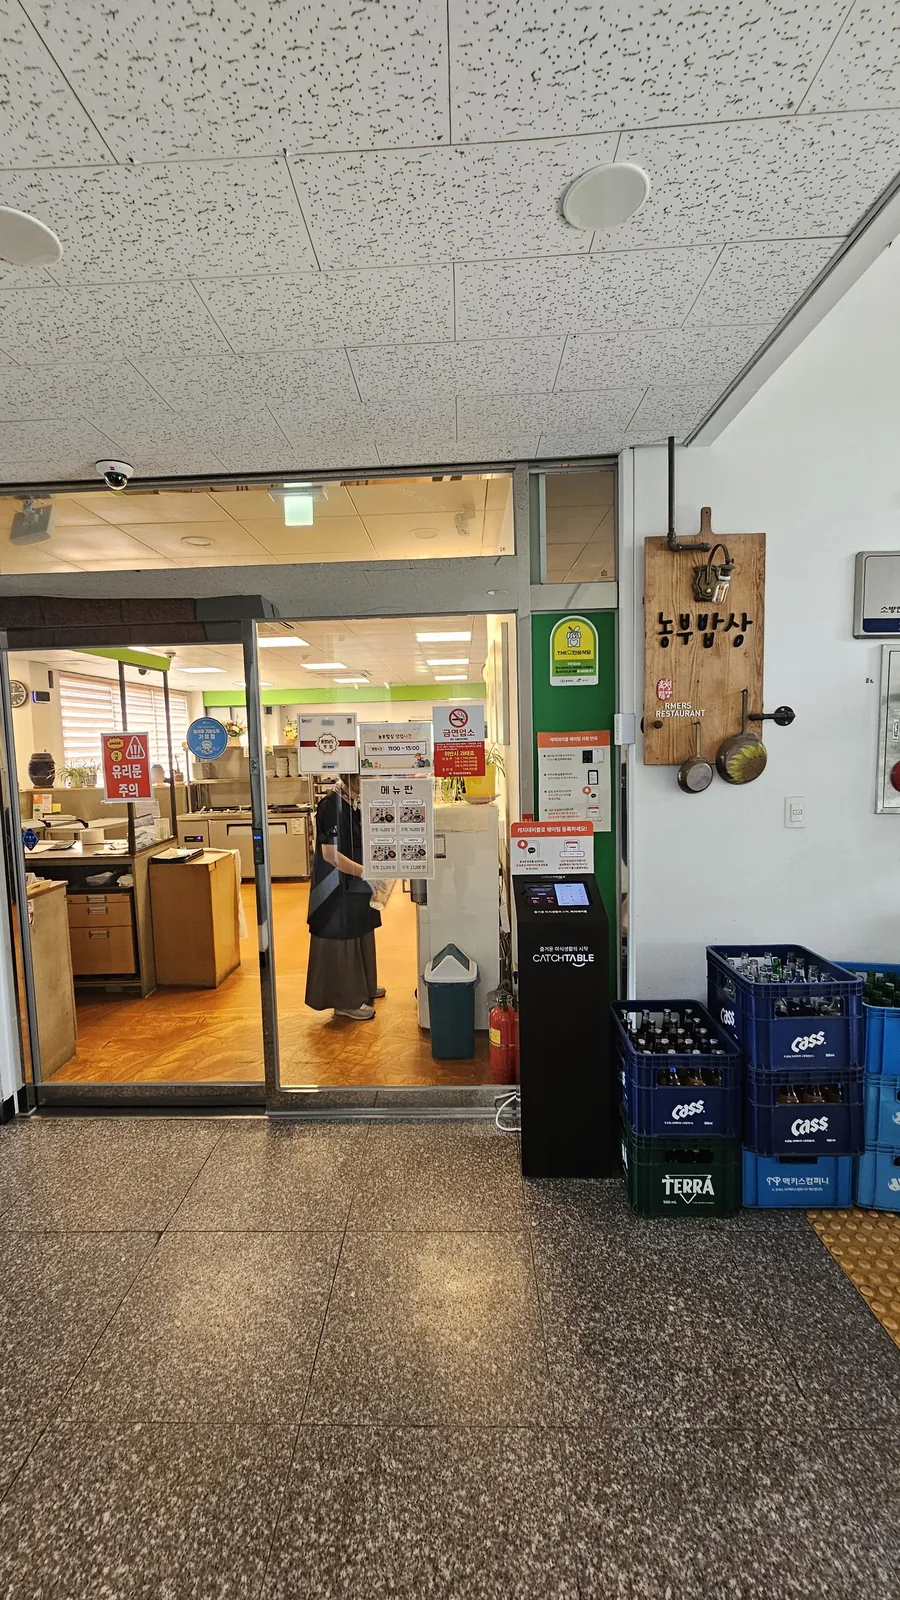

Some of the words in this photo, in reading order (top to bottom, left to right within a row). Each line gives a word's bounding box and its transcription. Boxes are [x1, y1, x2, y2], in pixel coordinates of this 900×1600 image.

[658, 611, 753, 648] 농부밥상
[655, 709, 706, 718] RESTAURANT
[664, 702, 692, 710] RMERS
[443, 728, 475, 738] 금연업소
[112, 763, 142, 779] 유리문
[119, 782, 139, 798] 주의
[532, 953, 595, 963] CATCHTABLE
[791, 1030, 826, 1053] Cass
[671, 1099, 706, 1120] Cass
[791, 1116, 829, 1137] Cass
[661, 1175, 715, 1196] TERRA
[782, 1177, 829, 1186] 맥키스컴퍼니
